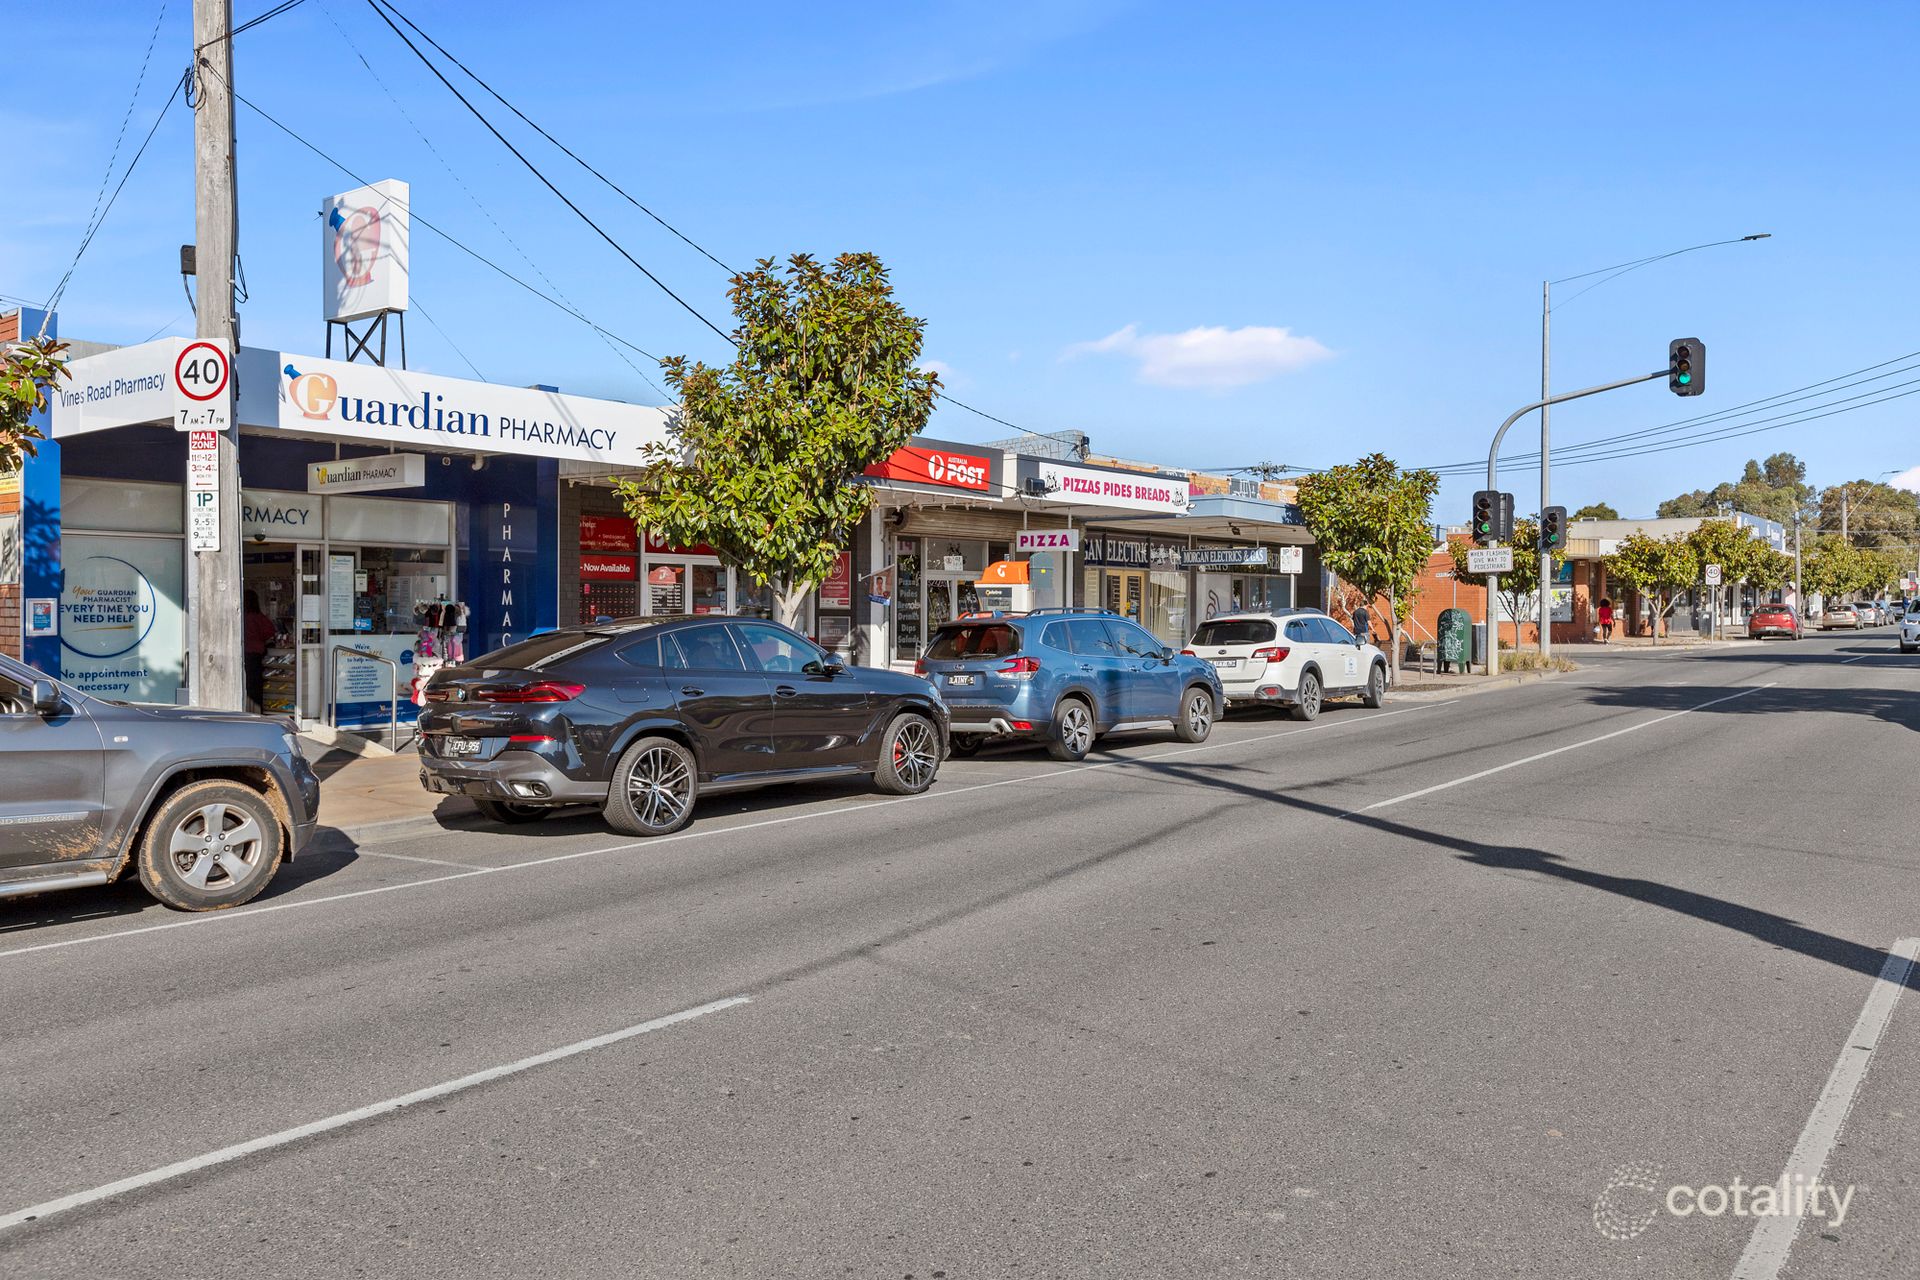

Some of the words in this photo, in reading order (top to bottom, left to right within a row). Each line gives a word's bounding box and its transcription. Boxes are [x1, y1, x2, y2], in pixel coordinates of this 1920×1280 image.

[183, 359, 219, 384] 40
[60, 388, 85, 408] Vines
[87, 381, 111, 402] Road
[115, 373, 166, 397] Pharmacy
[294, 372, 491, 437] Guardian
[500, 417, 617, 451] PHARMACY
[192, 432, 215, 440] MAIL
[191, 441, 216, 449] ZONE
[318, 466, 361, 485] Guardian
[362, 467, 398, 480] PHARMACY
[947, 463, 985, 484] POST
[1063, 476, 1100, 494] PIZZAS
[1104, 481, 1132, 498] PIDES
[1135, 486, 1170, 503] BREADS
[197, 493, 213, 507] 1P
[1020, 535, 1070, 547] PIZZA
[1183, 550, 1209, 563] MORGAN
[1210, 550, 1242, 562] ELECTRICS
[1243, 551, 1249, 560] &
[1250, 549, 1264, 561] GAS
[583, 563, 600, 571] Now
[600, 563, 630, 573] Available
[72, 585, 95, 599] Your
[59, 604, 94, 613] EVERY
[97, 604, 123, 613] TIME
[126, 604, 149, 613] YOU
[73, 614, 104, 623] NEED
[107, 614, 135, 623] HELP
[901, 624, 916, 633] Dips
[78, 668, 148, 682] appointment
[77, 683, 130, 693] necessary
